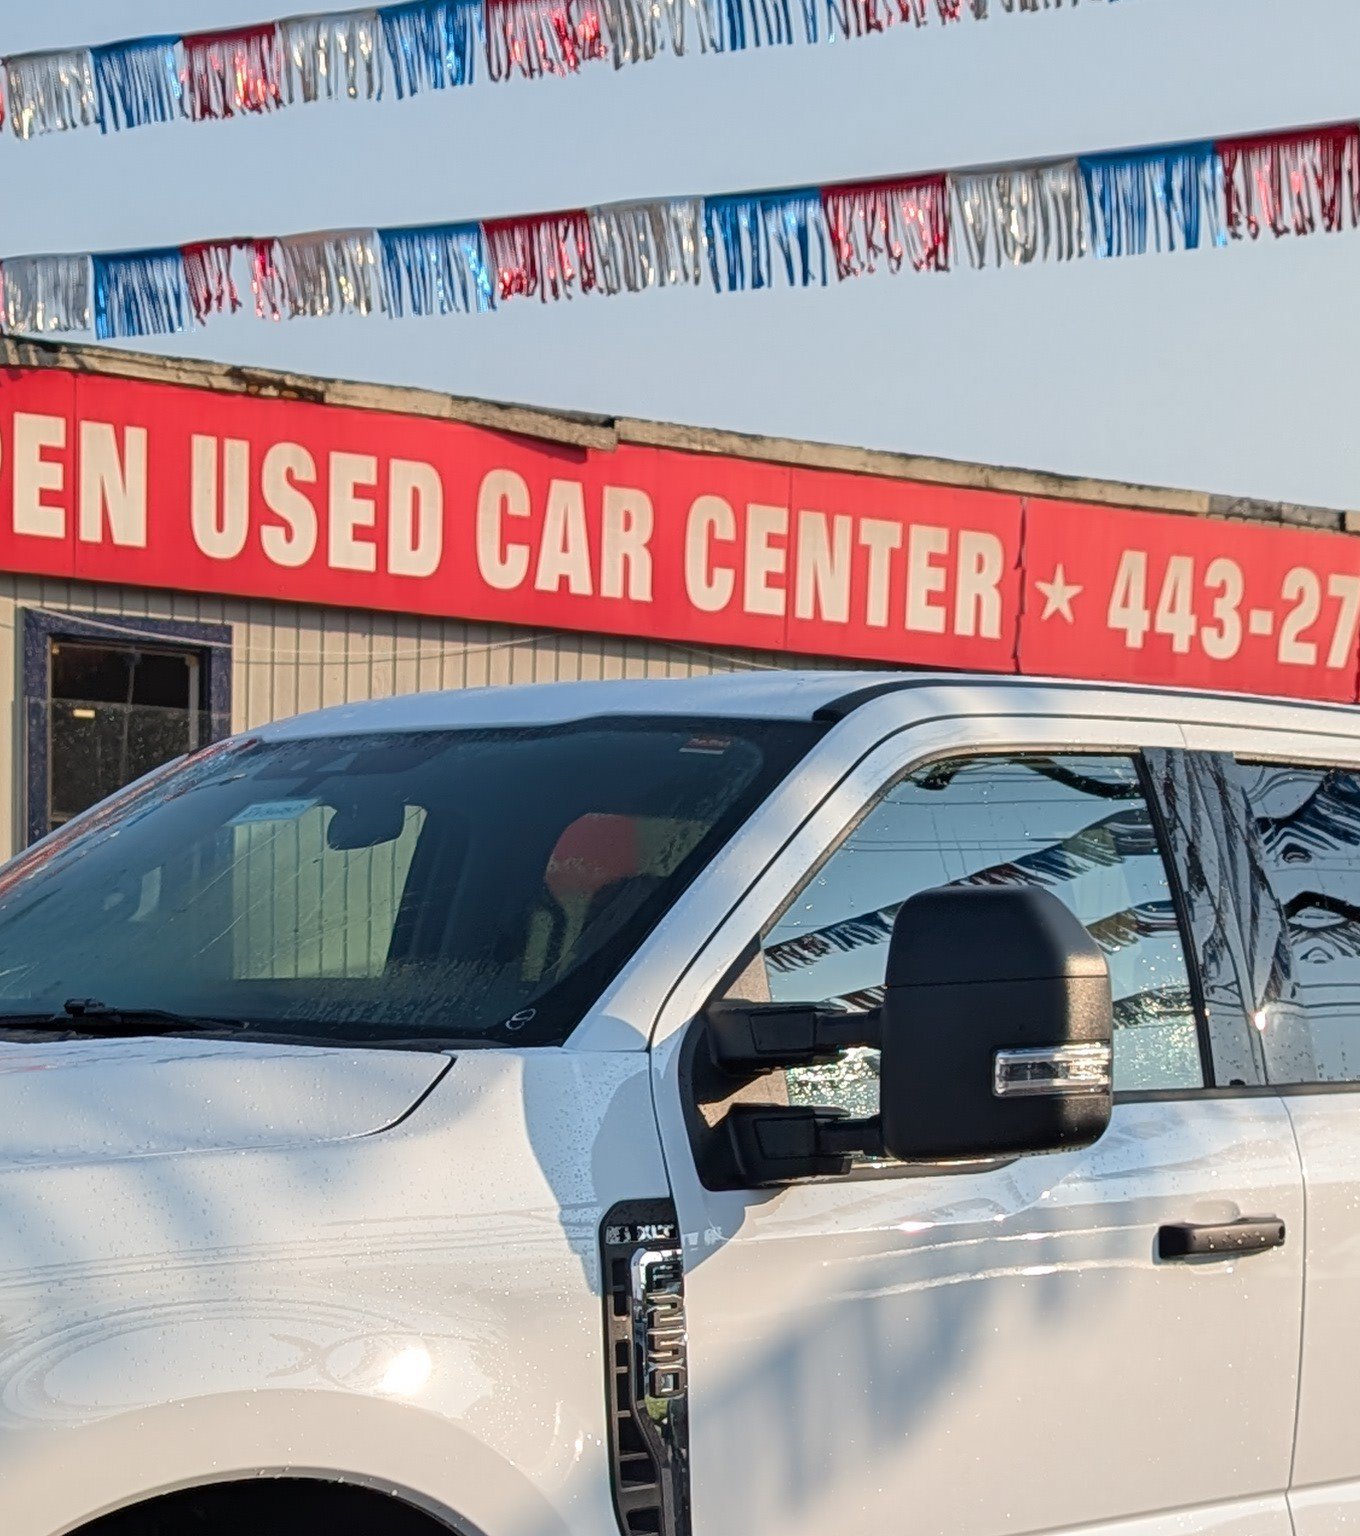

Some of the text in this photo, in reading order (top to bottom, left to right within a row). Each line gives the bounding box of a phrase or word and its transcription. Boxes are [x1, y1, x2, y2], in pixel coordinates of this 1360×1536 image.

[191, 436, 443, 578] USED
[477, 470, 653, 602] CAR
[685, 496, 1003, 639] CENTER
